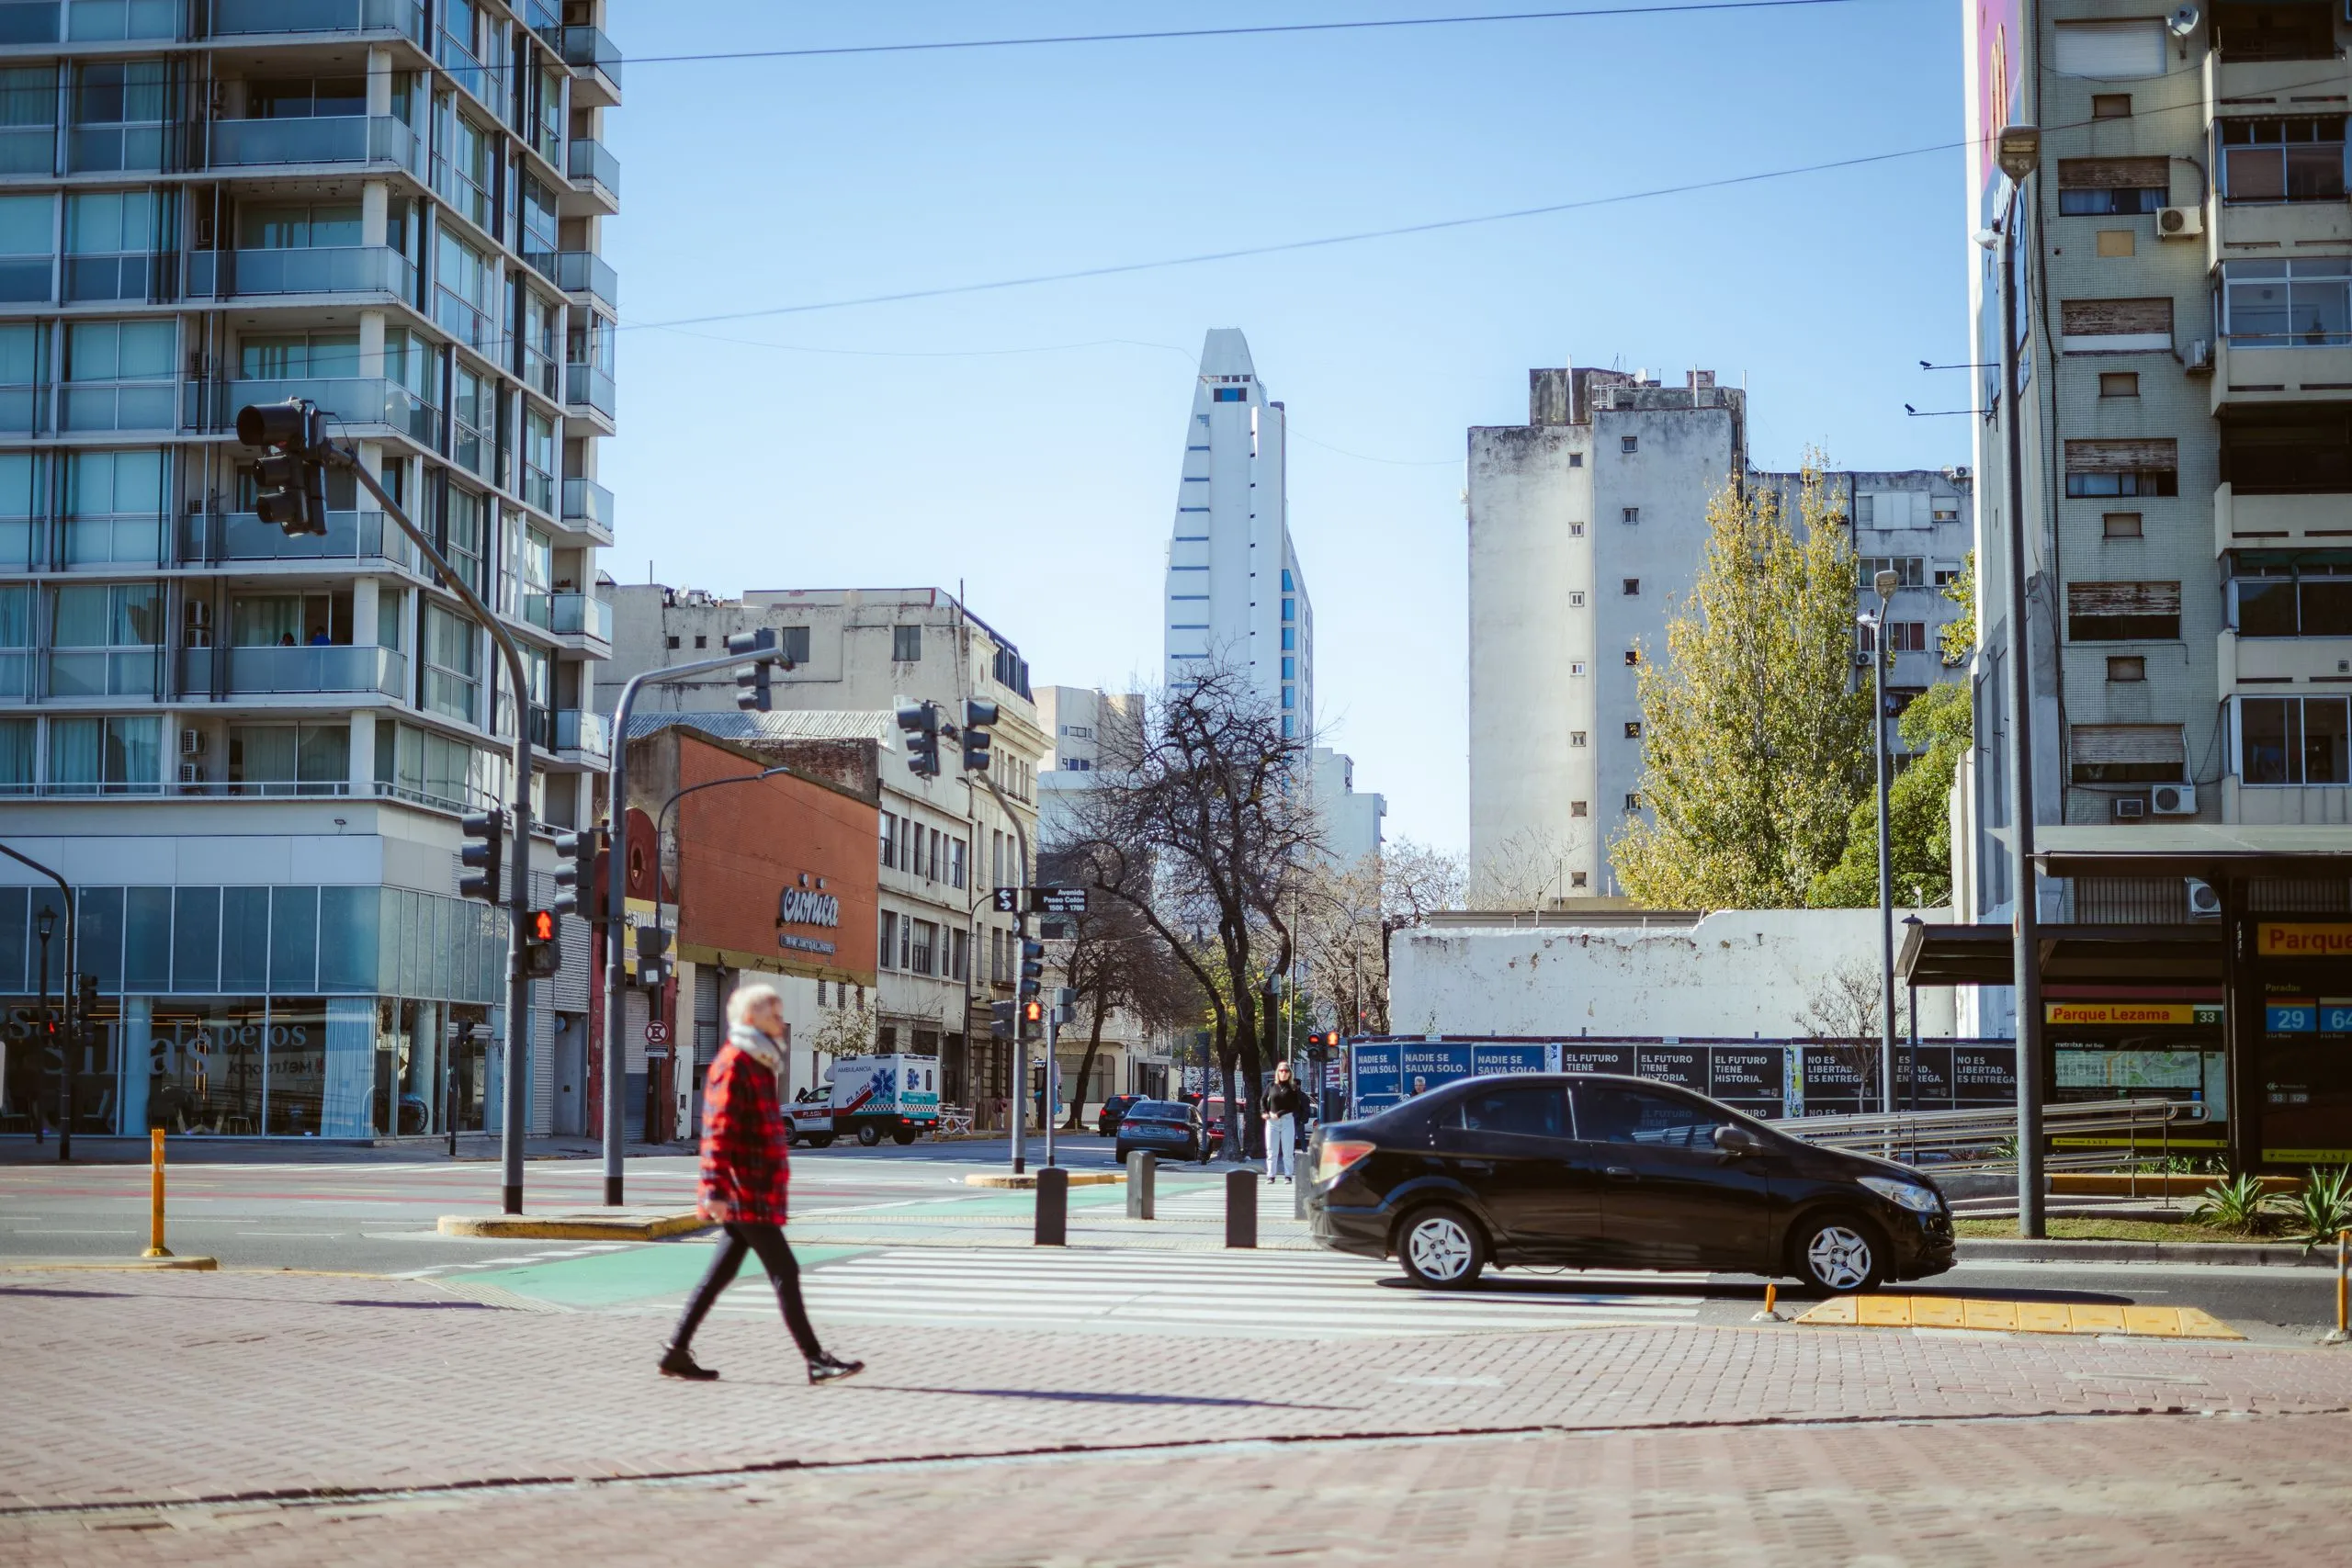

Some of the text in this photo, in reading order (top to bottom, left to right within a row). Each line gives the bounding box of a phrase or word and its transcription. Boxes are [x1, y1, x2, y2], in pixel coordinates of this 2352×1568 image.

[2269, 928, 2352, 954] Parque
[2265, 982, 2301, 992] Paradas
[2053, 1008, 2170, 1022] Parque Lezama
[2199, 1011, 2215, 1022] 33
[2278, 1010, 2305, 1029] 29
[1358, 1055, 1388, 1064] NADIE SE
[1405, 1054, 1449, 1062] NADIE SE
[1477, 1055, 1522, 1064] NADIE SE
[1566, 1054, 1619, 1063] EL FUTURO
[1641, 1055, 1693, 1064] EL FUTURO
[1714, 1055, 1768, 1065] EL FUTURO
[1807, 1055, 1836, 1064] NO ES
[1898, 1055, 1911, 1064] ES
[1957, 1056, 1985, 1065] NO ES
[1358, 1065, 1398, 1074] SALVA SOLO.
[1405, 1064, 1466, 1073] SALVA SOLO.
[1957, 1066, 2007, 1074] LIBERTAD.
[1640, 1074, 1689, 1082] HISTORIA.
[1714, 1075, 1763, 1083] HISTORIA.
[1808, 1075, 1820, 1083] ES
[1360, 1105, 1380, 1113] NADIE
[1741, 1109, 1767, 1117] TURO
